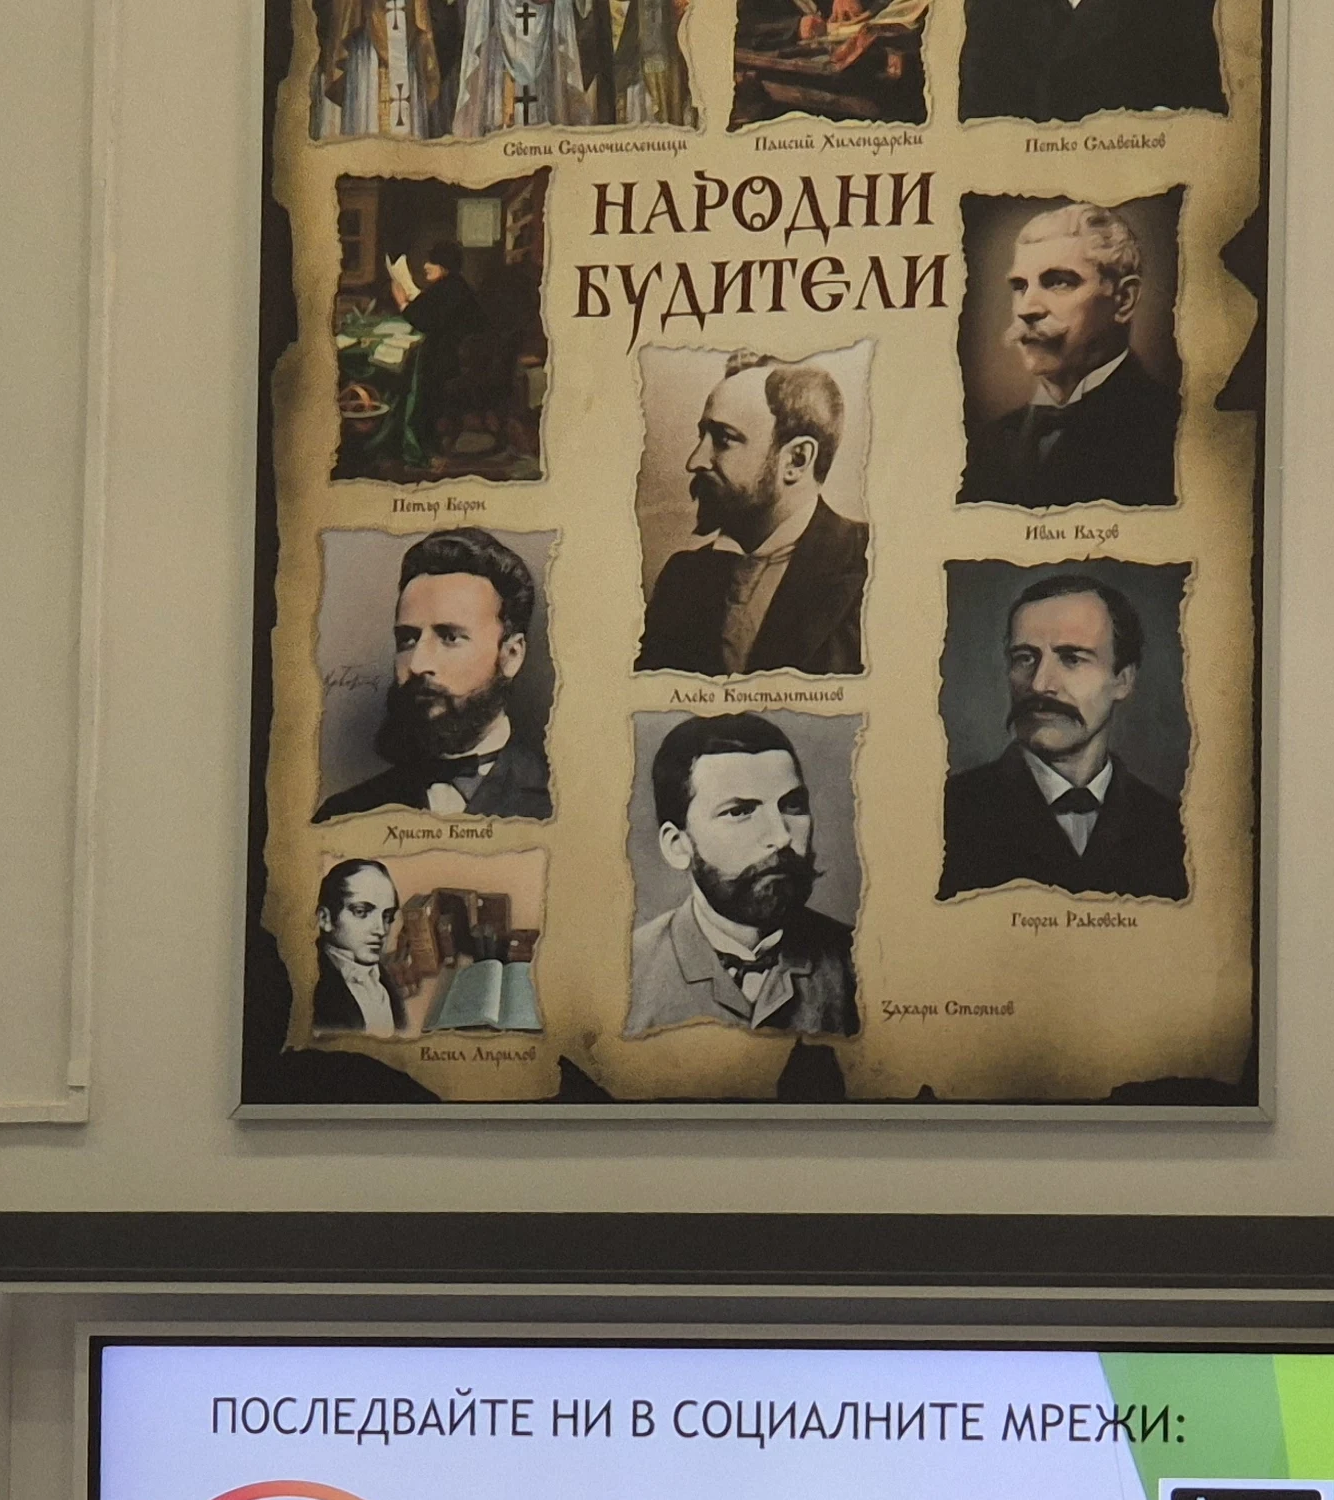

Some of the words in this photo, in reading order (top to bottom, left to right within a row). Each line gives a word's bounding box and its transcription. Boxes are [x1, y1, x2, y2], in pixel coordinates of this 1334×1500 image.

[1025, 137, 1079, 153] Петко
[1083, 131, 1167, 152] Славейков
[589, 169, 937, 248] НАРОДНИ
[572, 254, 951, 356] БУДИТЕЛИ
[1025, 524, 1066, 541] Иван
[1074, 523, 1120, 548] Вазов
[669, 688, 716, 704] Алеко
[723, 686, 845, 703] Константинов
[382, 825, 443, 849] Христо
[448, 822, 494, 839] Ботев
[1011, 912, 1059, 938] Георги
[1066, 909, 1139, 928] Раковски
[881, 1000, 939, 1024] Захари
[944, 1000, 1015, 1016] Стоянов
[420, 1046, 467, 1061] Васил
[210, 1388, 533, 1445] ПОСЛЕДВАЙТЕ
[551, 1401, 612, 1436] НИ
[630, 1401, 656, 1438] В
[672, 1400, 985, 1448] СОЦИАЛНИТЕ
[1001, 1403, 1187, 1444] МРЕЖИ:
